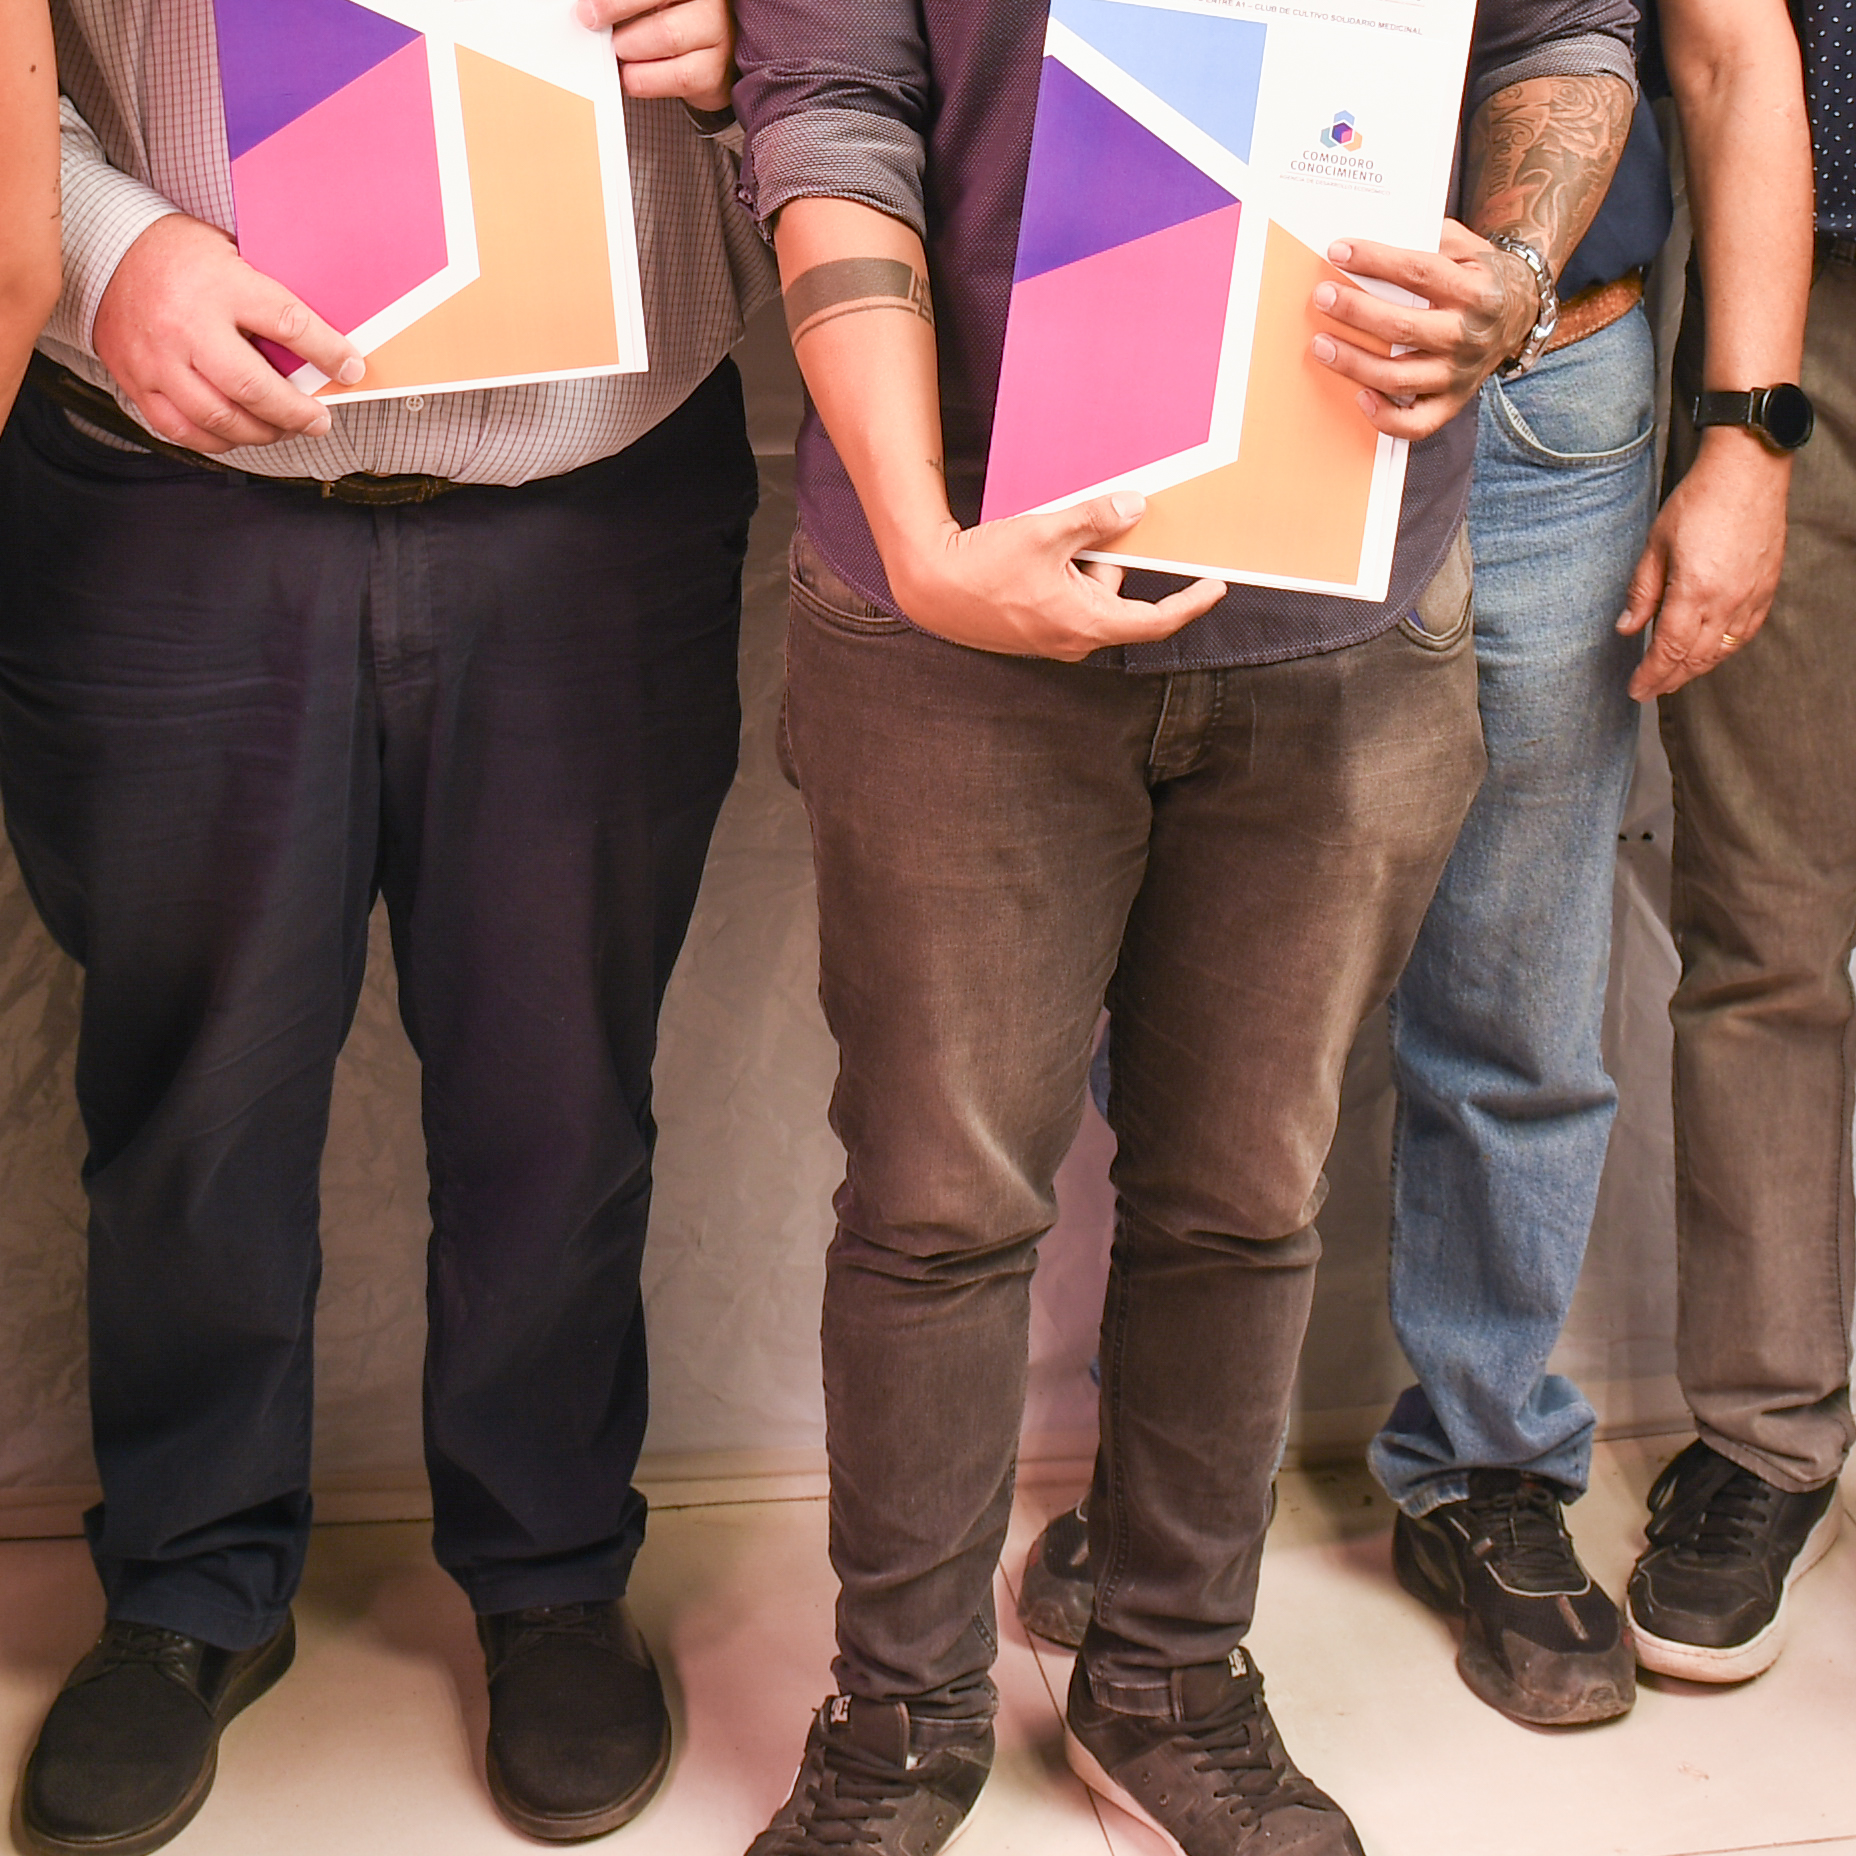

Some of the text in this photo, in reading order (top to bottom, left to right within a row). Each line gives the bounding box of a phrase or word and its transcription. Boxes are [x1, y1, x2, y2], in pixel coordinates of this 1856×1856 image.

[1235, 0, 1246, 8] A1
[1255, 4, 1277, 13] CLUB
[1279, 7, 1291, 15] DE
[1292, 8, 1329, 21] CULTIVO
[1330, 14, 1376, 28] SOLIDARIO
[1377, 21, 1423, 36] MEDICINAL
[1290, 160, 1383, 184] CONOCIMIENTO
[1302, 150, 1374, 170] COMODORO
